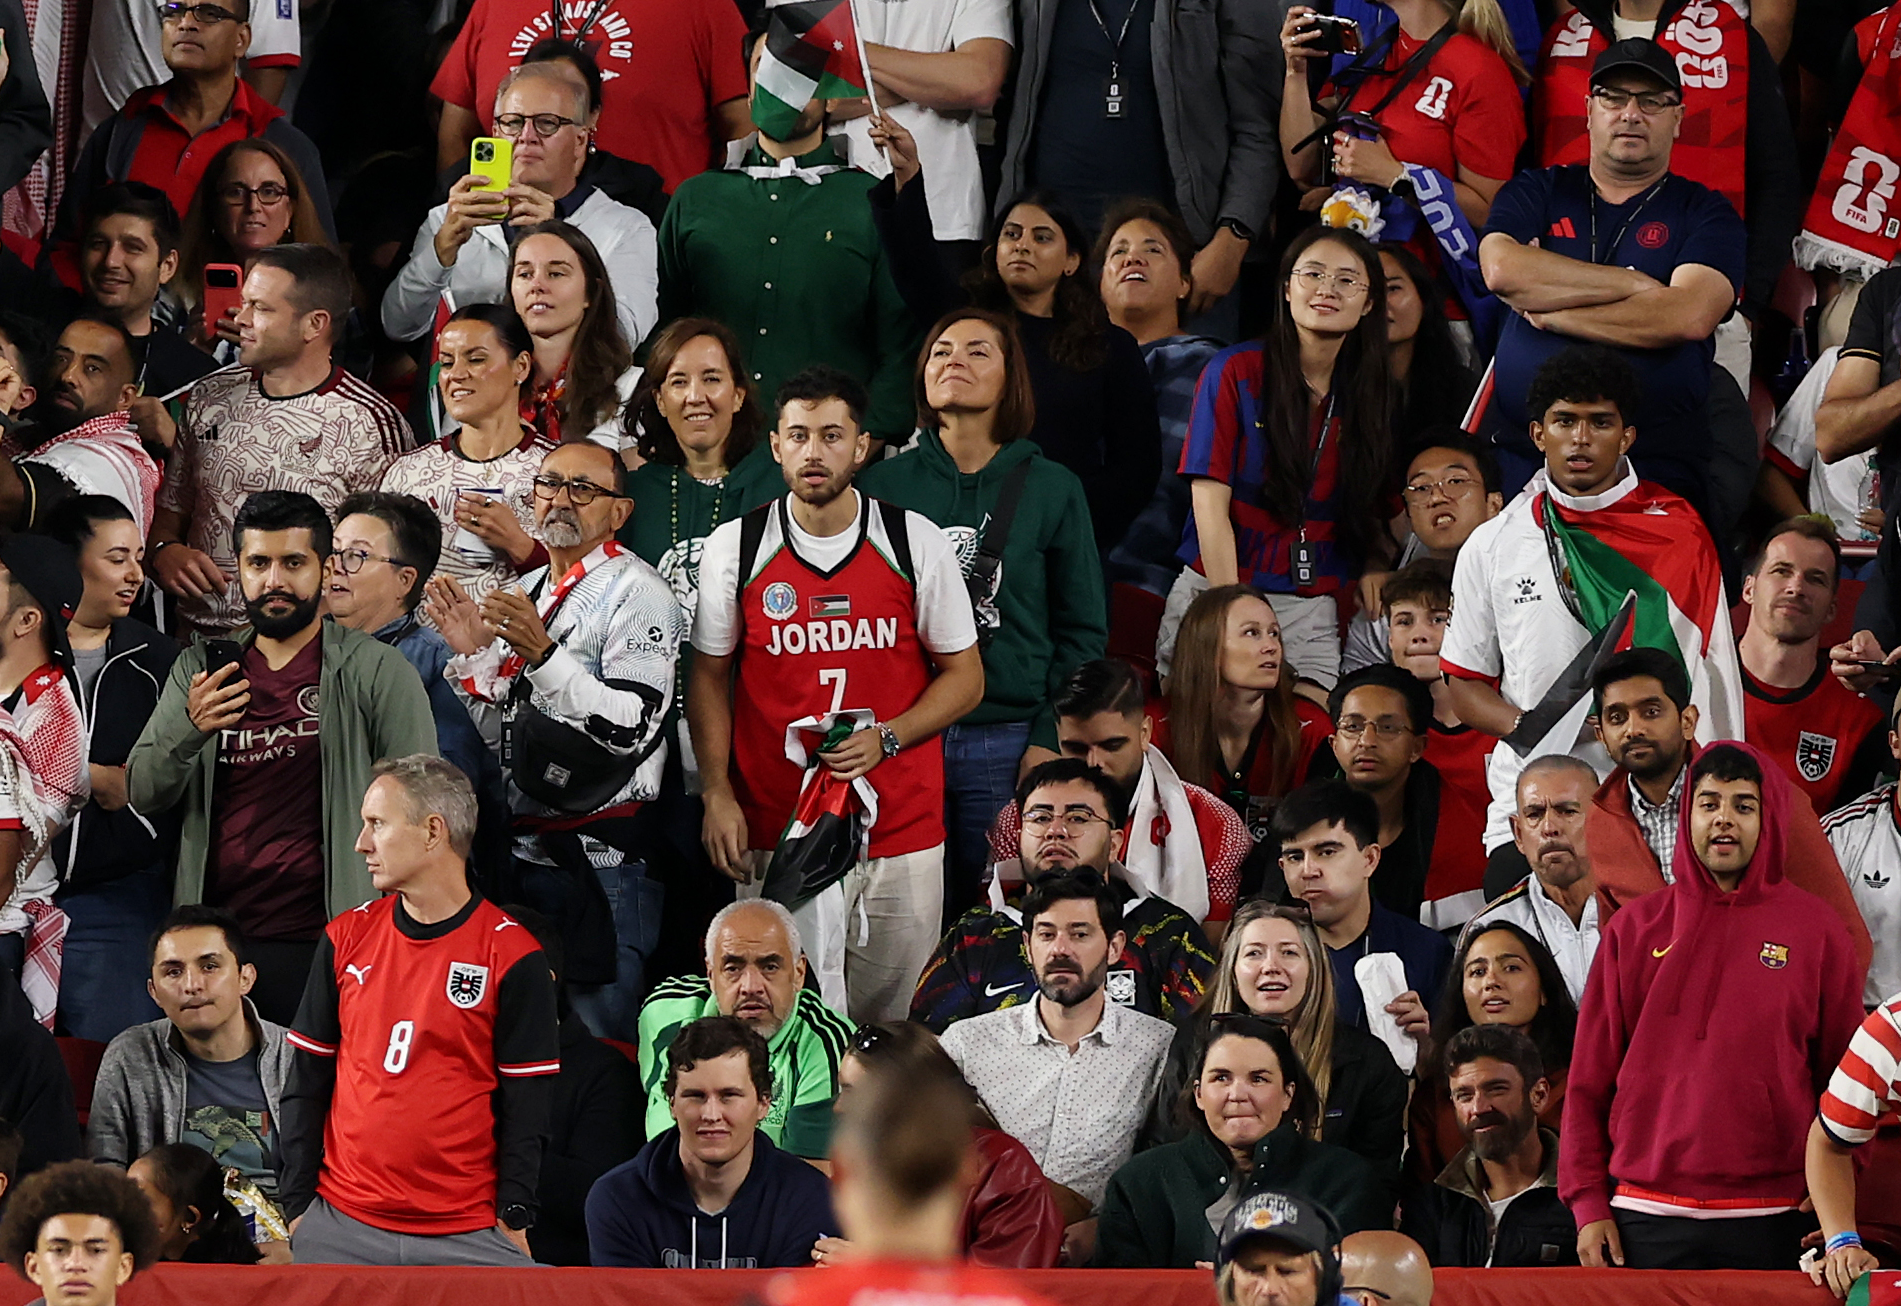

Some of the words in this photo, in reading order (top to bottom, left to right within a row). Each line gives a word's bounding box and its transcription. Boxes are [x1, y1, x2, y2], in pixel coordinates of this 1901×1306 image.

[508, 26, 539, 57] LEVI
[532, 0, 608, 32] STAUS
[598, 11, 632, 50] AND
[1845, 208, 1870, 225] FIFA
[1514, 594, 1543, 606] KELME
[765, 618, 899, 657] JORDAN
[819, 668, 847, 716] 7
[219, 719, 320, 751] TIHAD
[382, 1019, 415, 1074] 8
